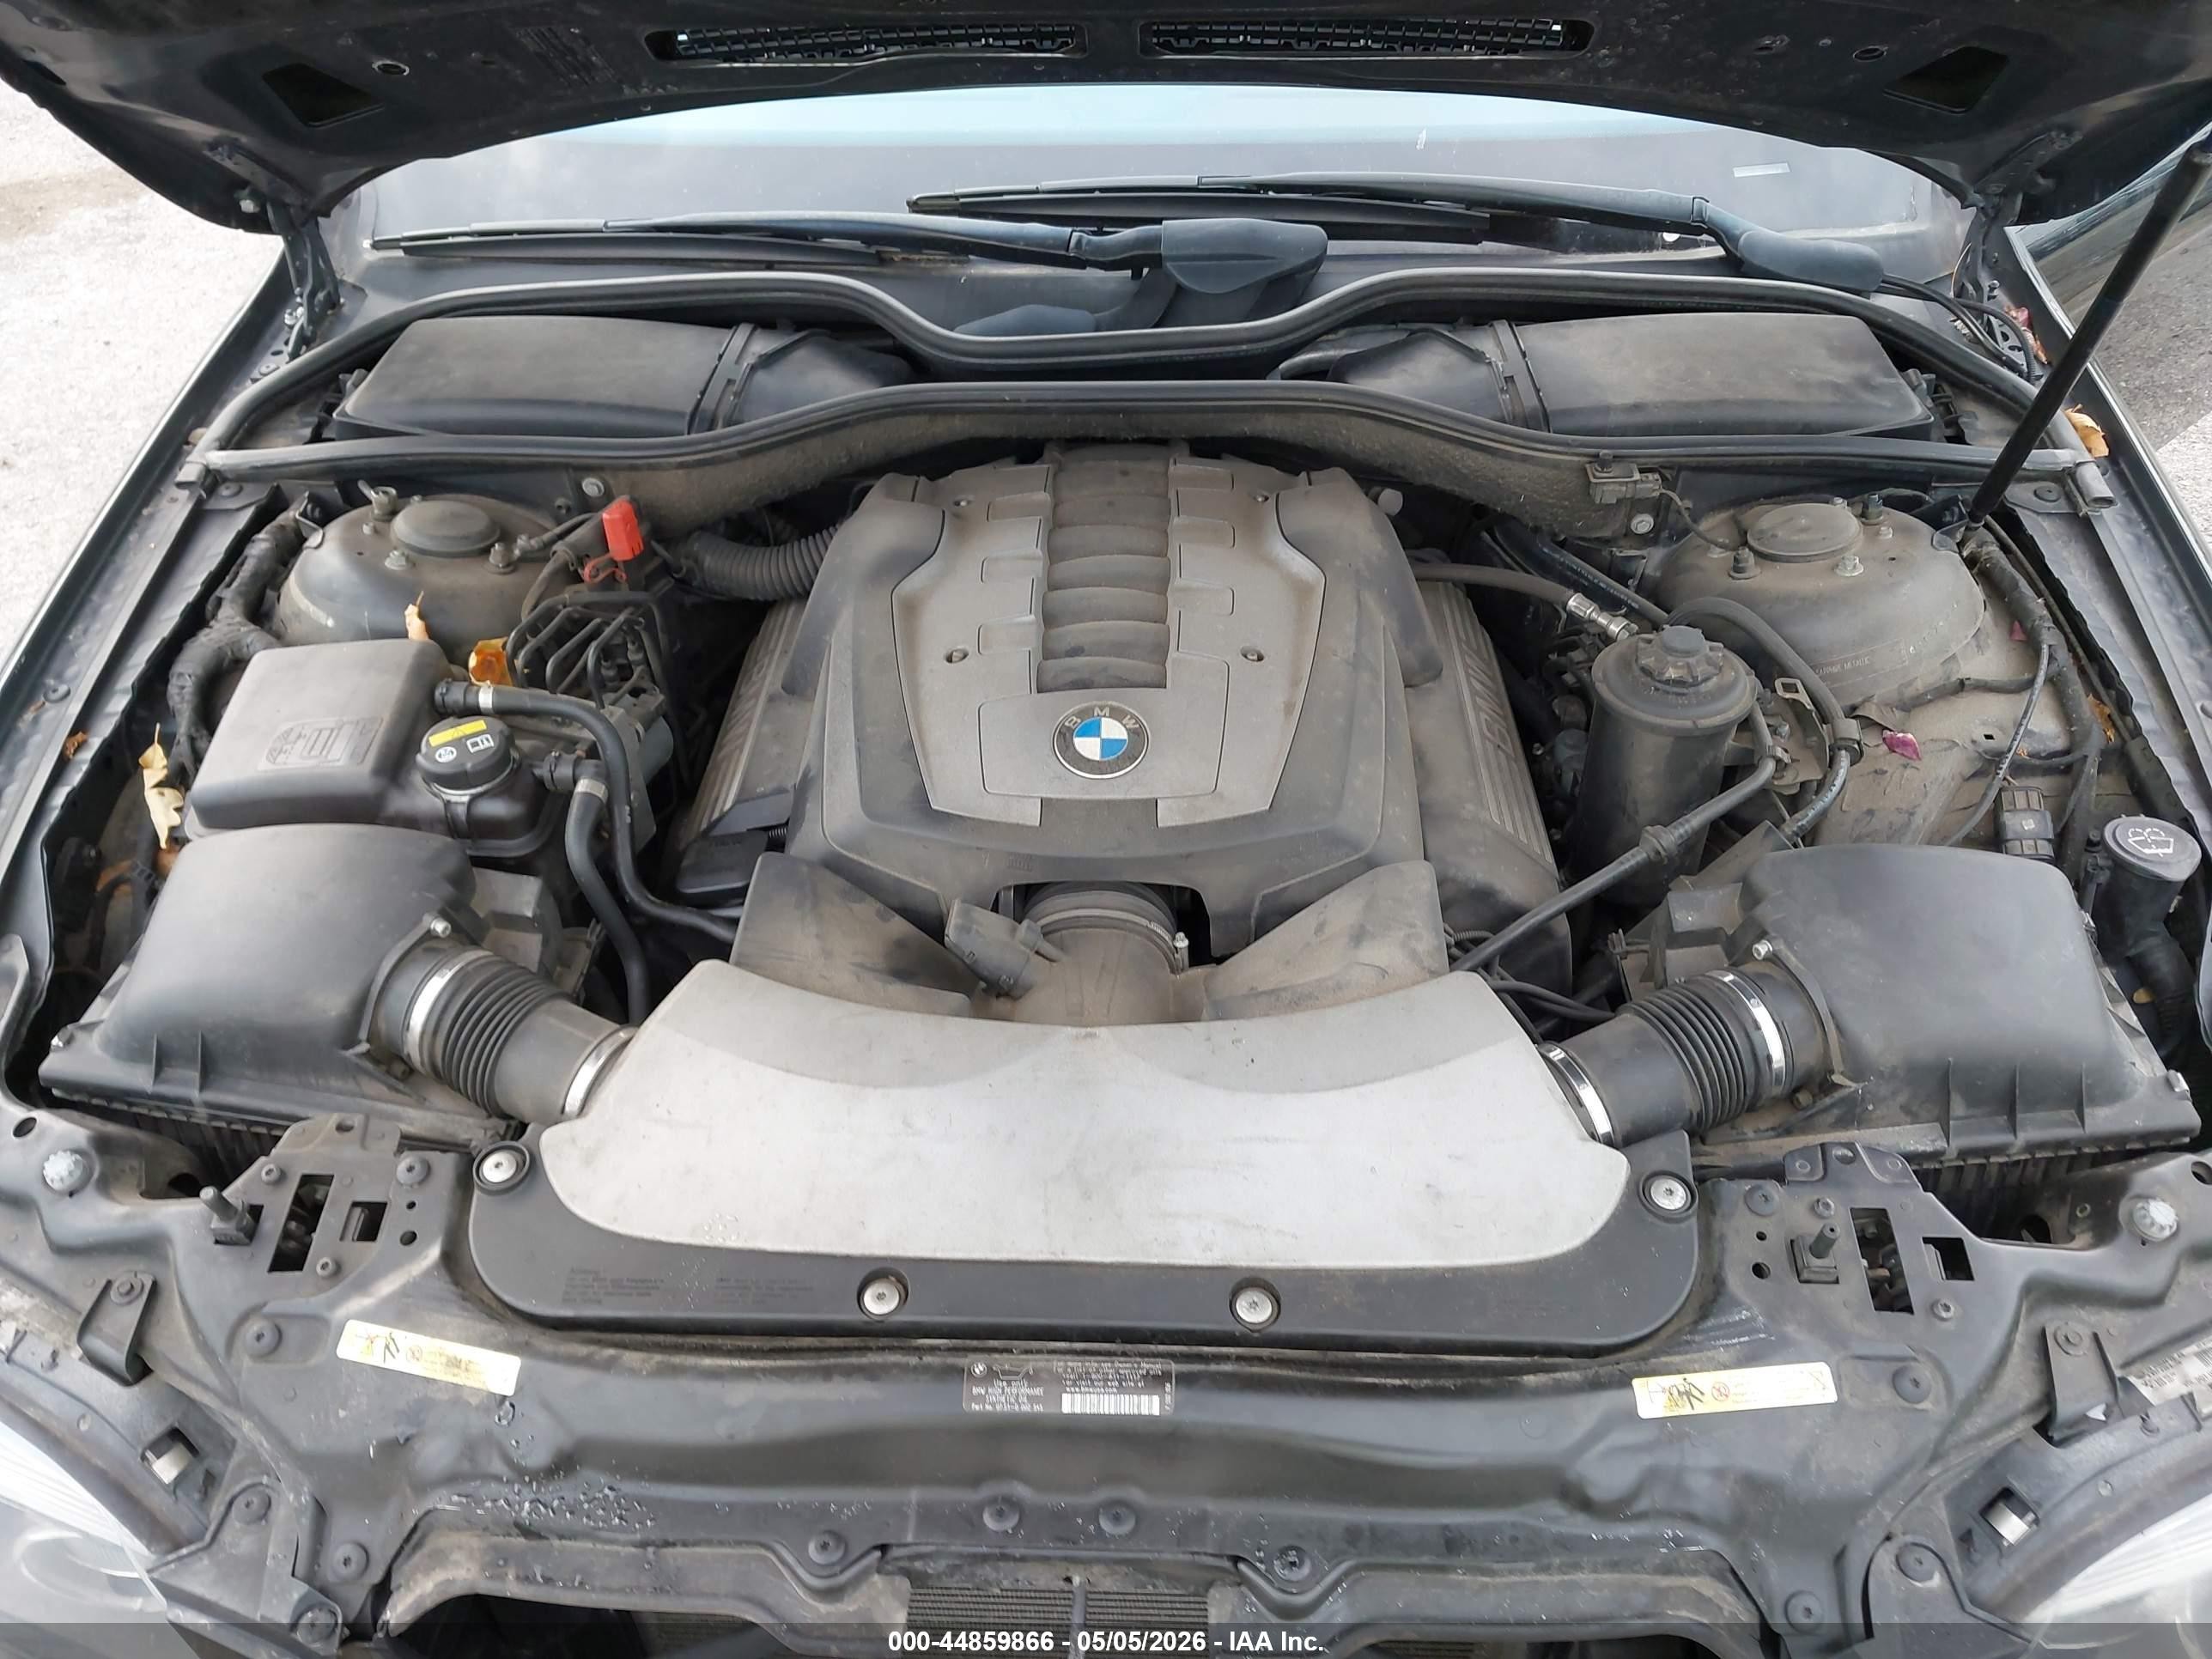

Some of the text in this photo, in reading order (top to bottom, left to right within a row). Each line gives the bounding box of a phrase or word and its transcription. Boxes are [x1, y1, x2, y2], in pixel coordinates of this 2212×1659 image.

[1064, 707, 1139, 729] BMW
[994, 1379, 1007, 1388] Use
[972, 1386, 986, 1395] BMW
[1004, 1387, 1044, 1396] PERFORMANCE
